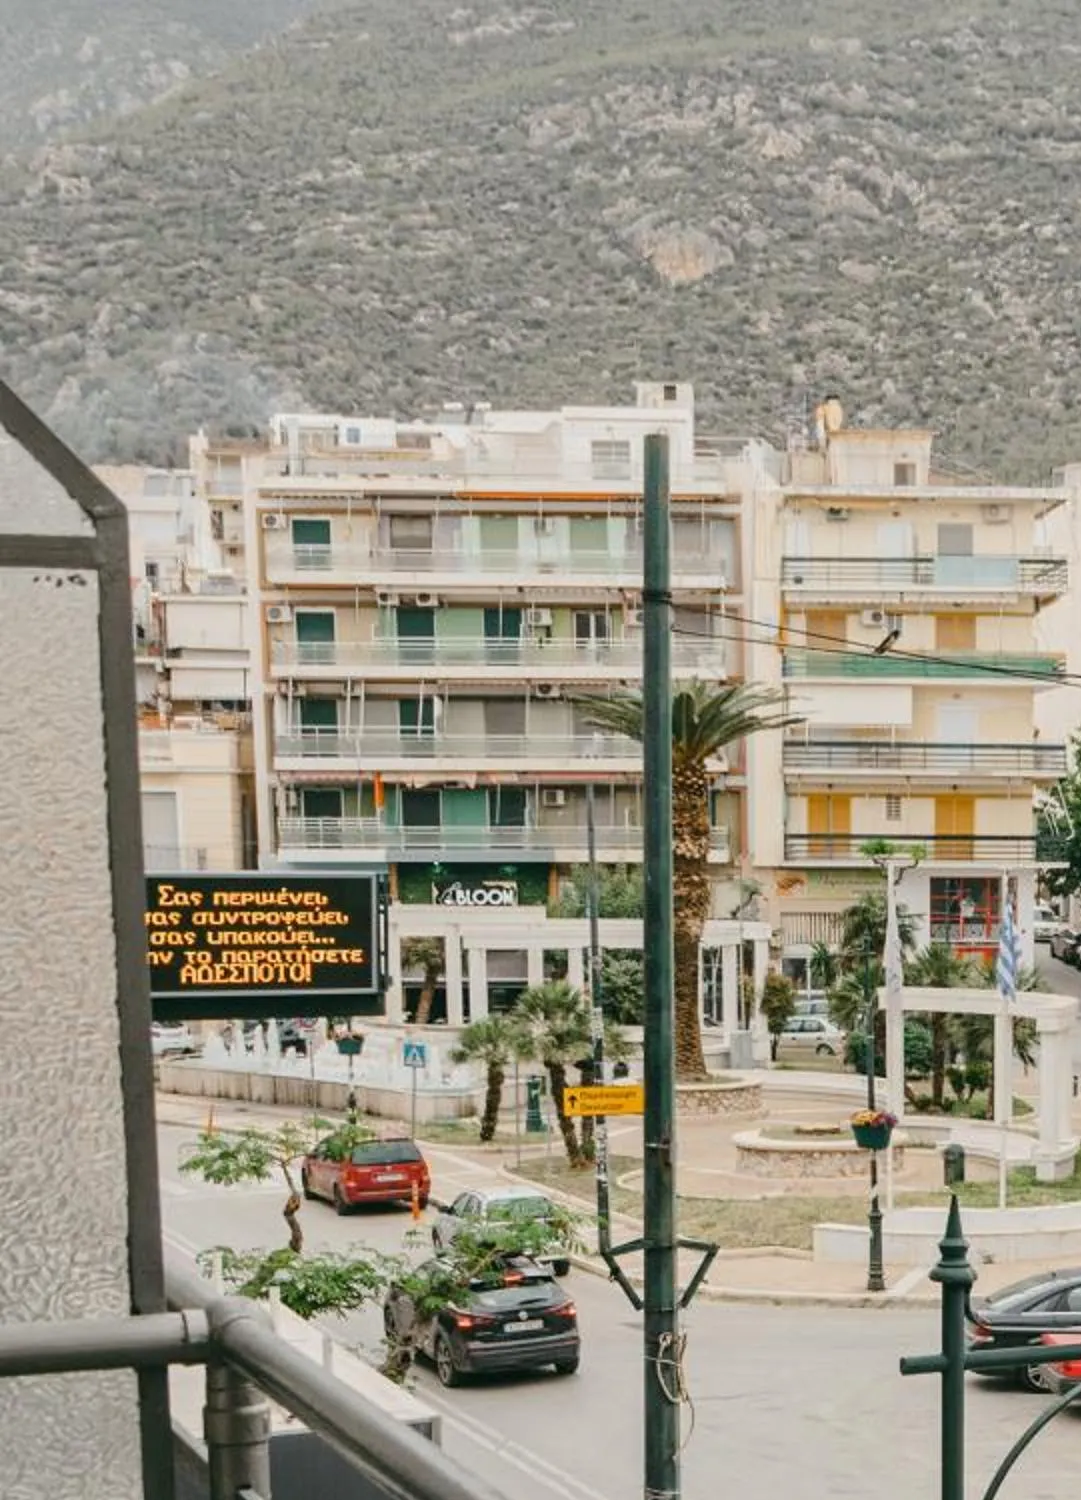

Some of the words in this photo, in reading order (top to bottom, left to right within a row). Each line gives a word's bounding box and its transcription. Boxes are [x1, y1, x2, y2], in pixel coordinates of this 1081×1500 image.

[158, 885, 203, 906] Σας
[150, 931, 197, 945] σας
[145, 950, 174, 965] ην
[183, 950, 213, 964] το
[222, 945, 363, 964] παρατήσετε
[180, 963, 312, 984] ΑΔΕΣΠΟΤΟ!
